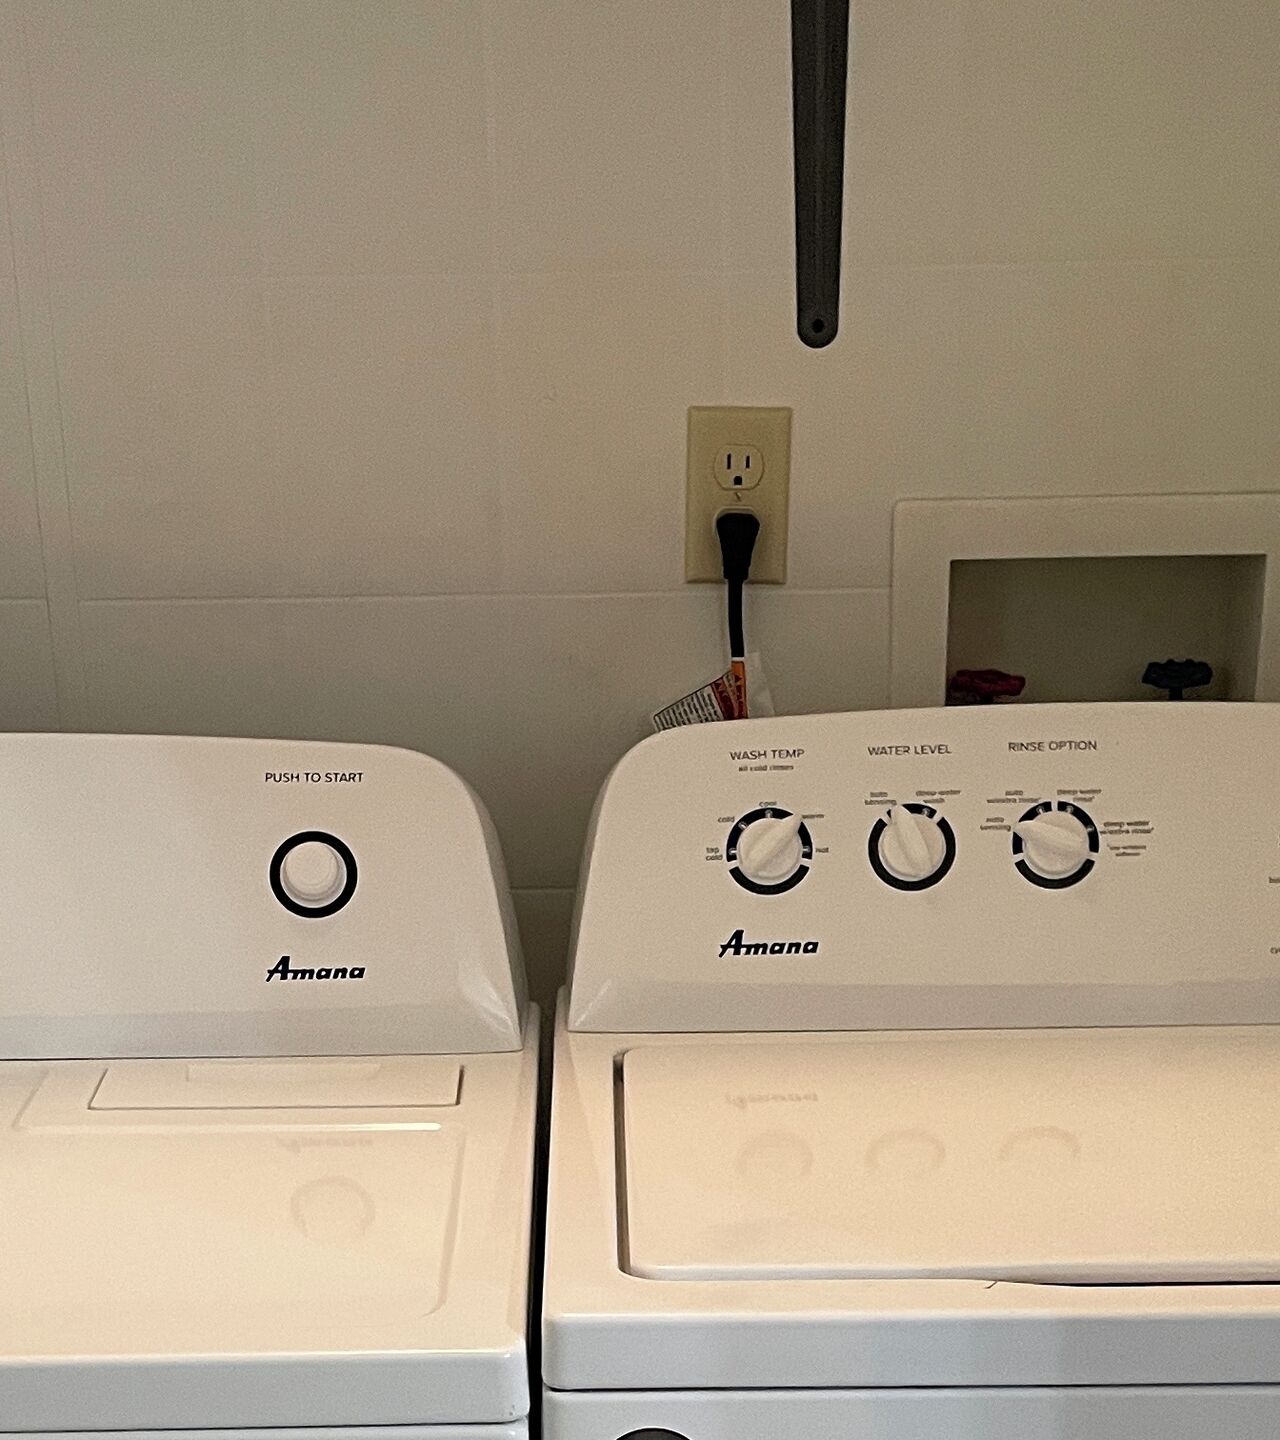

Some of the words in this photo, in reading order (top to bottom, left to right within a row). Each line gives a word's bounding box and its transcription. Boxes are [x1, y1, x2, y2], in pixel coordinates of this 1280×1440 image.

[868, 745, 910, 756] WATER
[914, 744, 952, 755] LEVEL
[1008, 742, 1045, 752] RINSE
[1048, 740, 1097, 751] OPTION
[730, 750, 767, 760] WASH
[771, 749, 805, 759] TEMP
[265, 772, 300, 783] PUSH
[304, 772, 321, 783] TO
[325, 772, 364, 783] START
[718, 929, 819, 958] Amana
[265, 955, 366, 982] Amana
